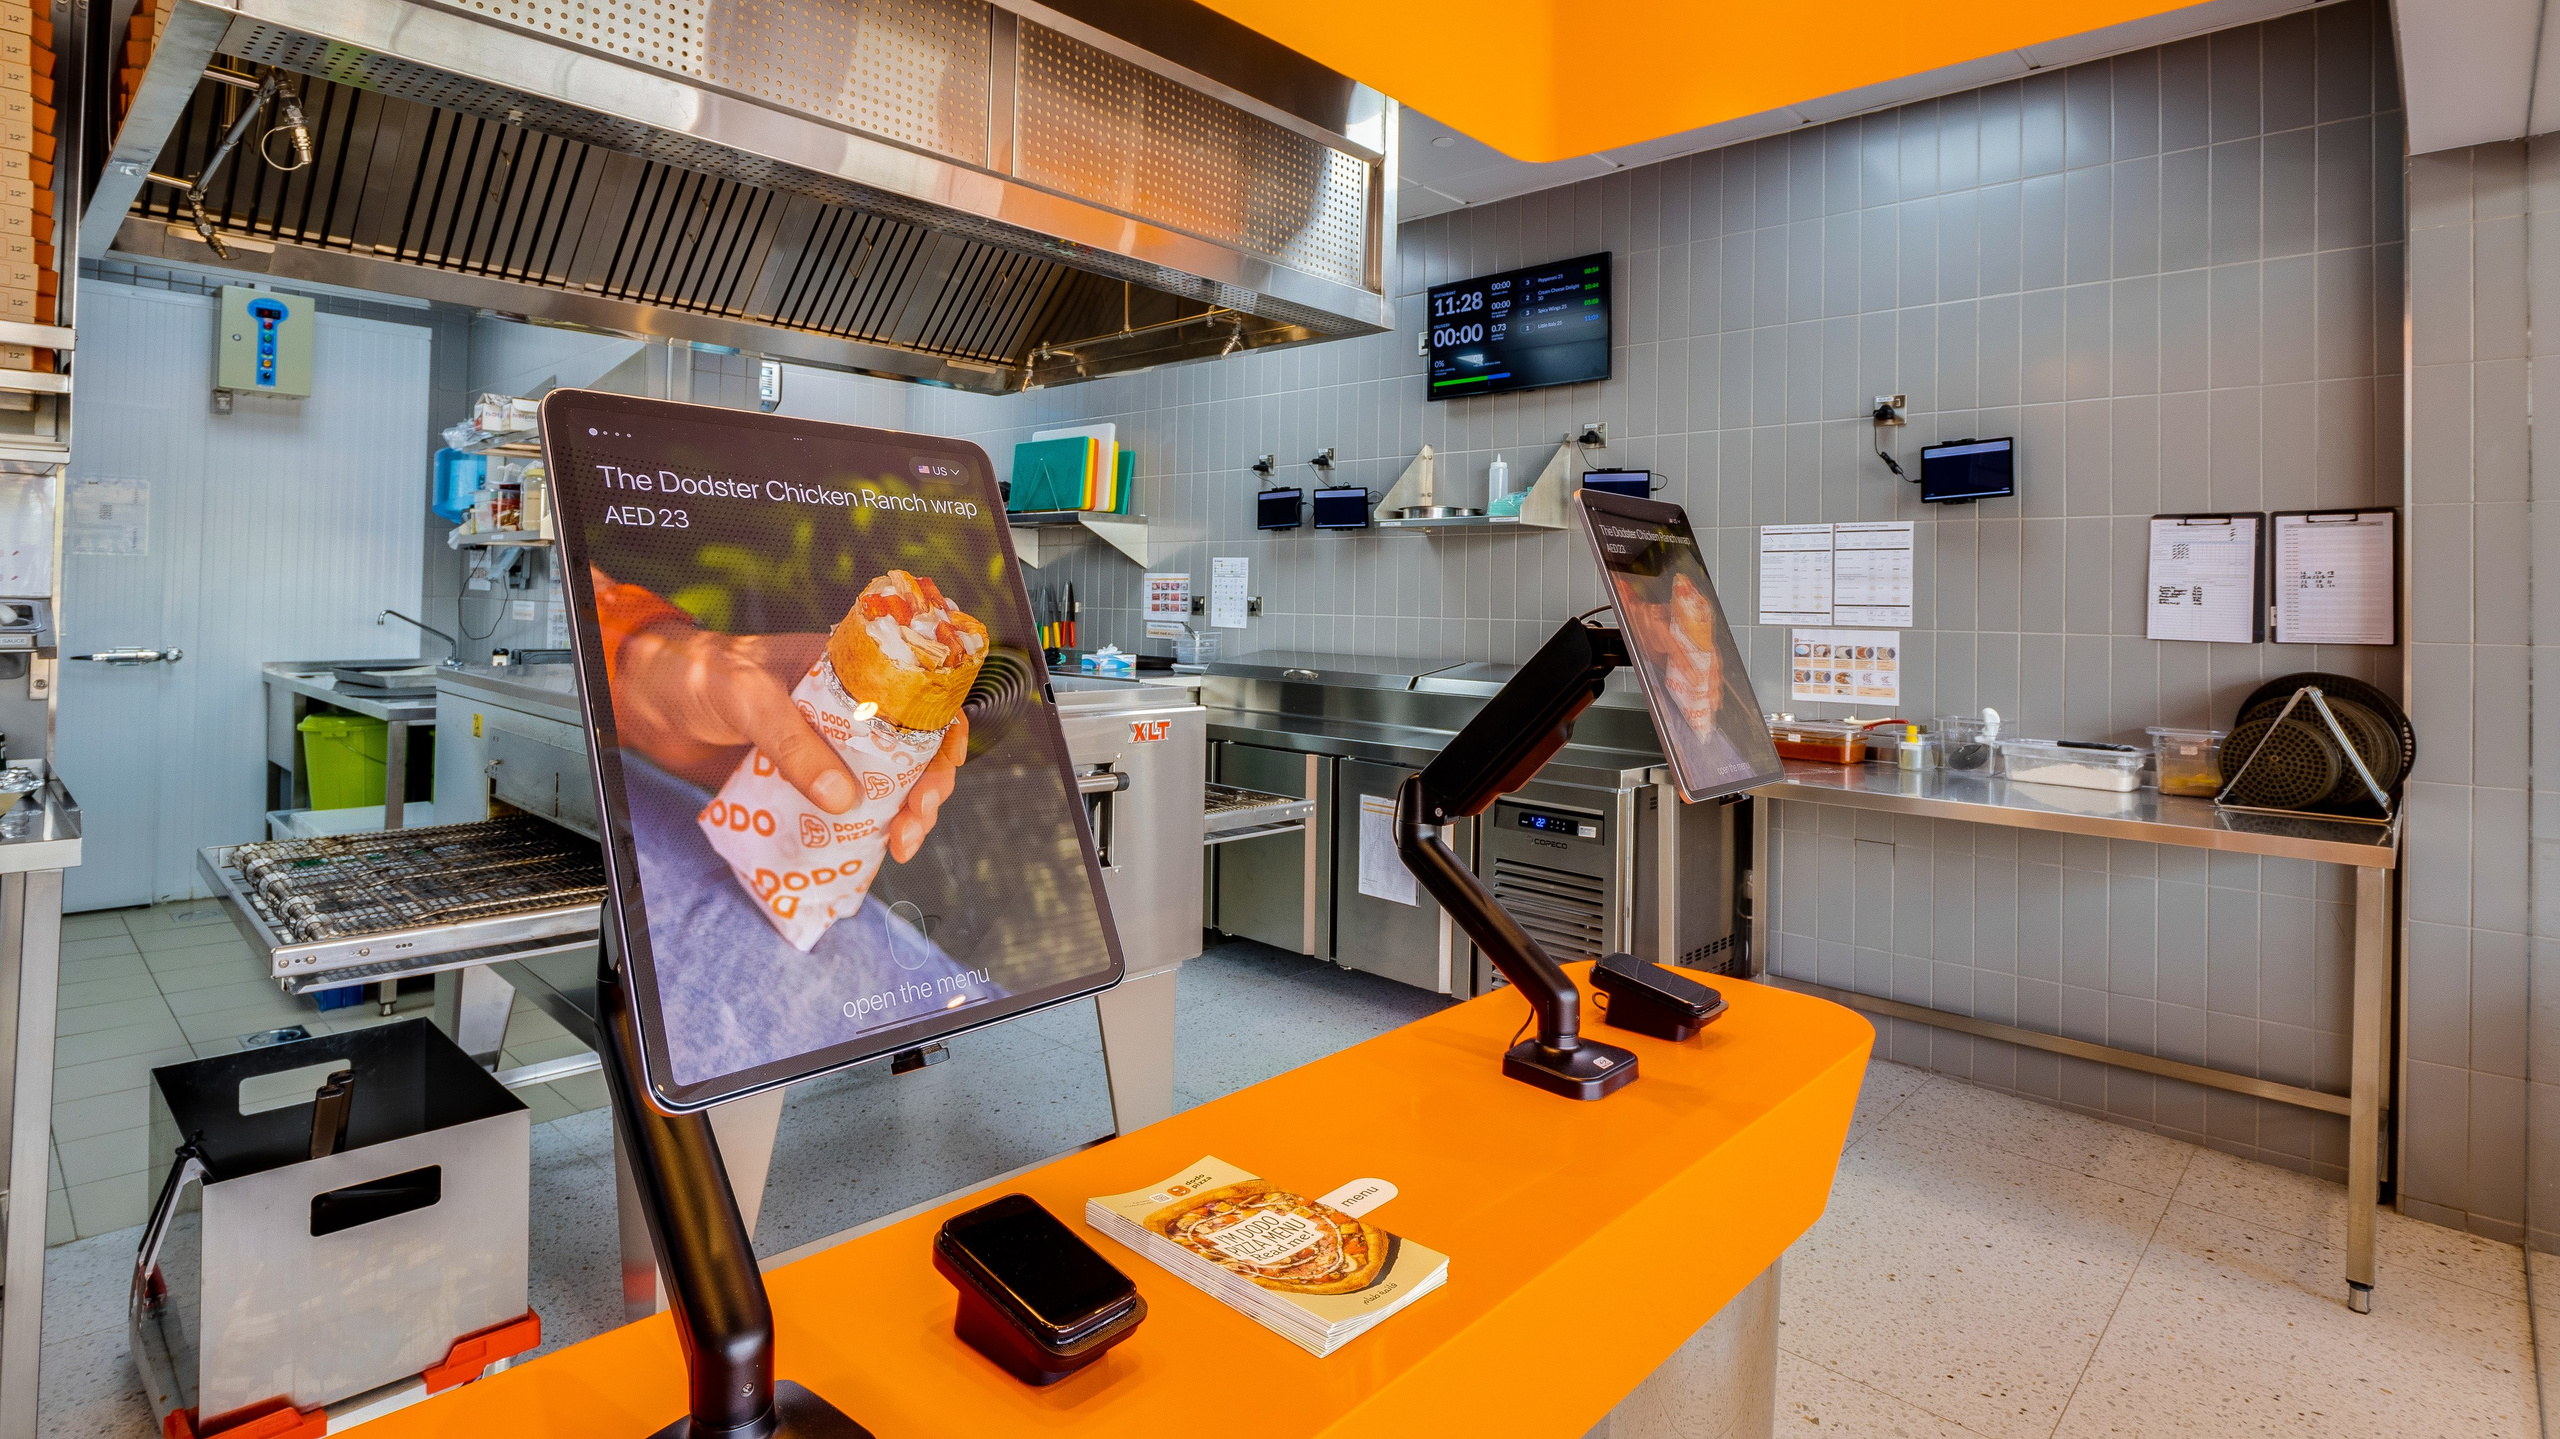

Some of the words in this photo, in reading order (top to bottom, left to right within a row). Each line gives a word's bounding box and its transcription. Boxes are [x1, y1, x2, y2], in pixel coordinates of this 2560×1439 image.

[1491, 281, 1511, 290] 00:00
[1435, 292, 1483, 316] 11:28
[1491, 300, 1511, 310] 00:00
[1434, 323, 1483, 348] 00:00
[1491, 323, 1506, 332] 0.73
[932, 465, 948, 476] US
[596, 465, 652, 491] The
[658, 470, 759, 499] Dodster
[766, 480, 858, 507] Chicken
[861, 489, 927, 512] Ranch
[930, 499, 977, 520] wrap
[605, 505, 655, 526] AED
[658, 509, 690, 528] 23
[1599, 525, 1613, 536] The
[1613, 526, 1637, 539] Dodster
[1636, 529, 1659, 541] Chicken
[1659, 532, 1677, 543] Ranch
[1677, 537, 1690, 546] wrap
[1607, 544, 1618, 553] AED
[1619, 544, 1626, 554] 23
[821, 710, 851, 729] DODO
[1130, 720, 1171, 743] XLT
[897, 763, 927, 782] DOD
[1717, 766, 1730, 776] open
[1737, 762, 1750, 771] menu
[698, 799, 776, 837] ODO
[833, 819, 874, 833] DODO
[835, 825, 880, 844] PIZZA
[1534, 838, 1568, 849] COPECO
[843, 991, 896, 1020] open
[899, 982, 932, 1003] the
[937, 968, 990, 994] menu
[1185, 1174, 1204, 1186] dodo
[1192, 1176, 1212, 1189] pizza
[1341, 1186, 1379, 1207] menu
[1235, 1216, 1279, 1238] DODO
[1224, 1239, 1272, 1257] PIZZA
[1262, 1218, 1306, 1243] MENU
[1250, 1244, 1290, 1261] Read
[1287, 1230, 1314, 1247] me!
